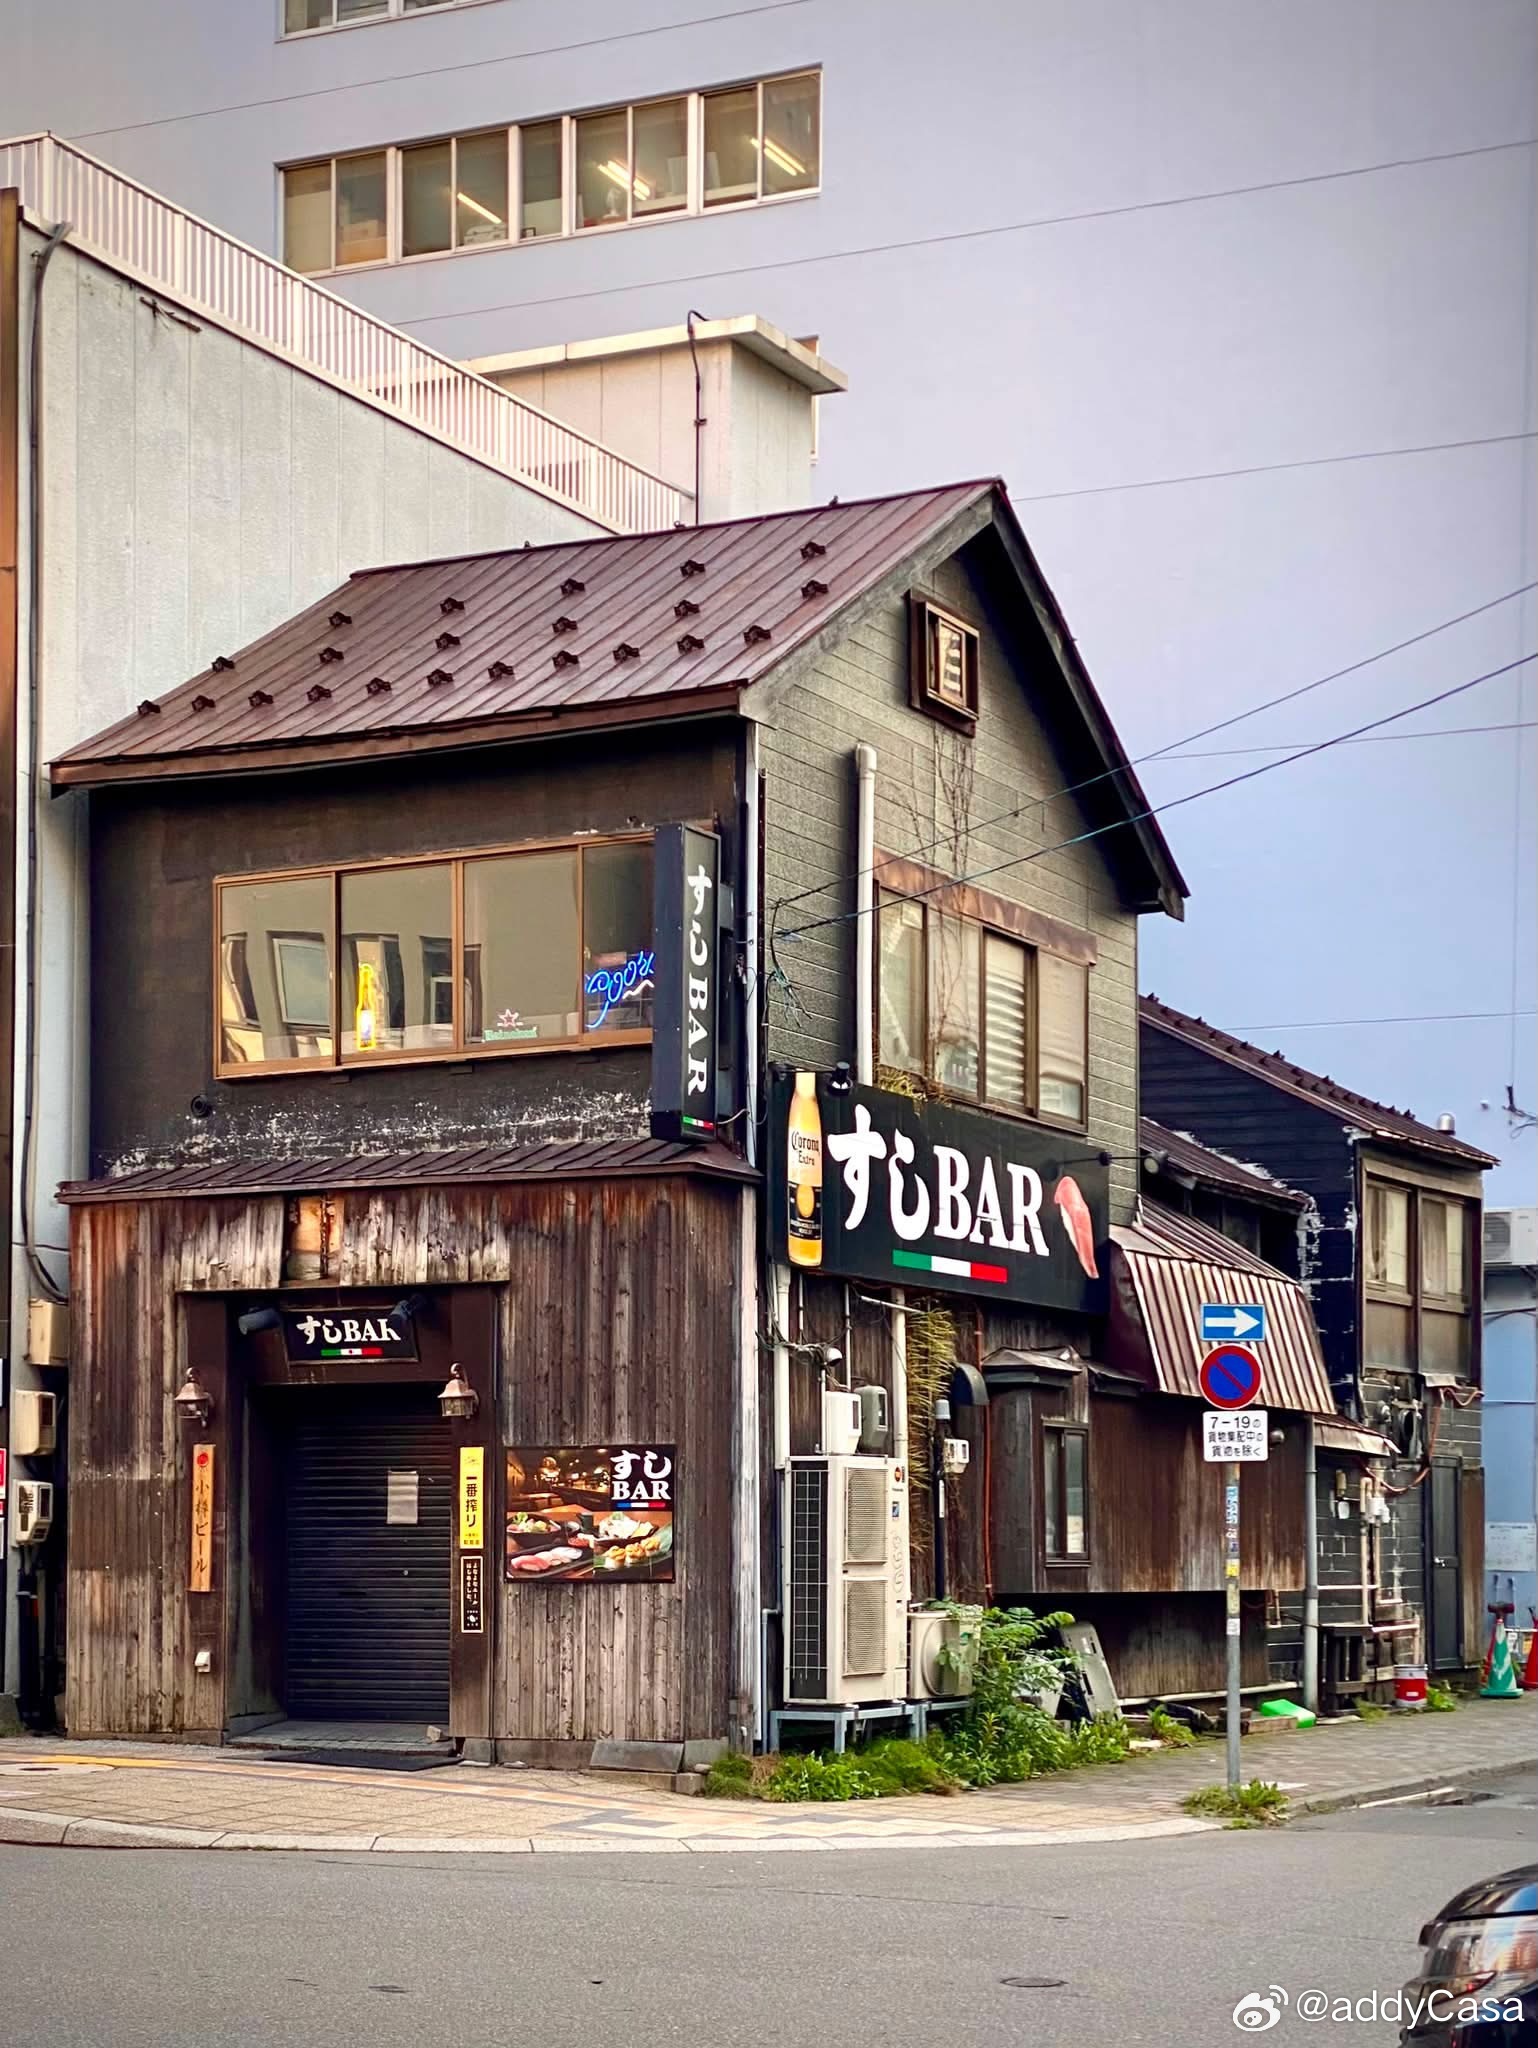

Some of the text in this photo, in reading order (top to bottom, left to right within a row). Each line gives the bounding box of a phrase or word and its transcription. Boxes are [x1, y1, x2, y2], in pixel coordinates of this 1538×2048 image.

[687, 865, 713, 1096] すしBAR
[791, 1131, 821, 1155] Corona
[798, 1150, 815, 1166] Extra
[827, 1103, 1050, 1257] すしBAR
[609, 1449, 672, 1480] すし
[465, 1475, 478, 1528] 一番搾り
[611, 1480, 672, 1500] BAR
